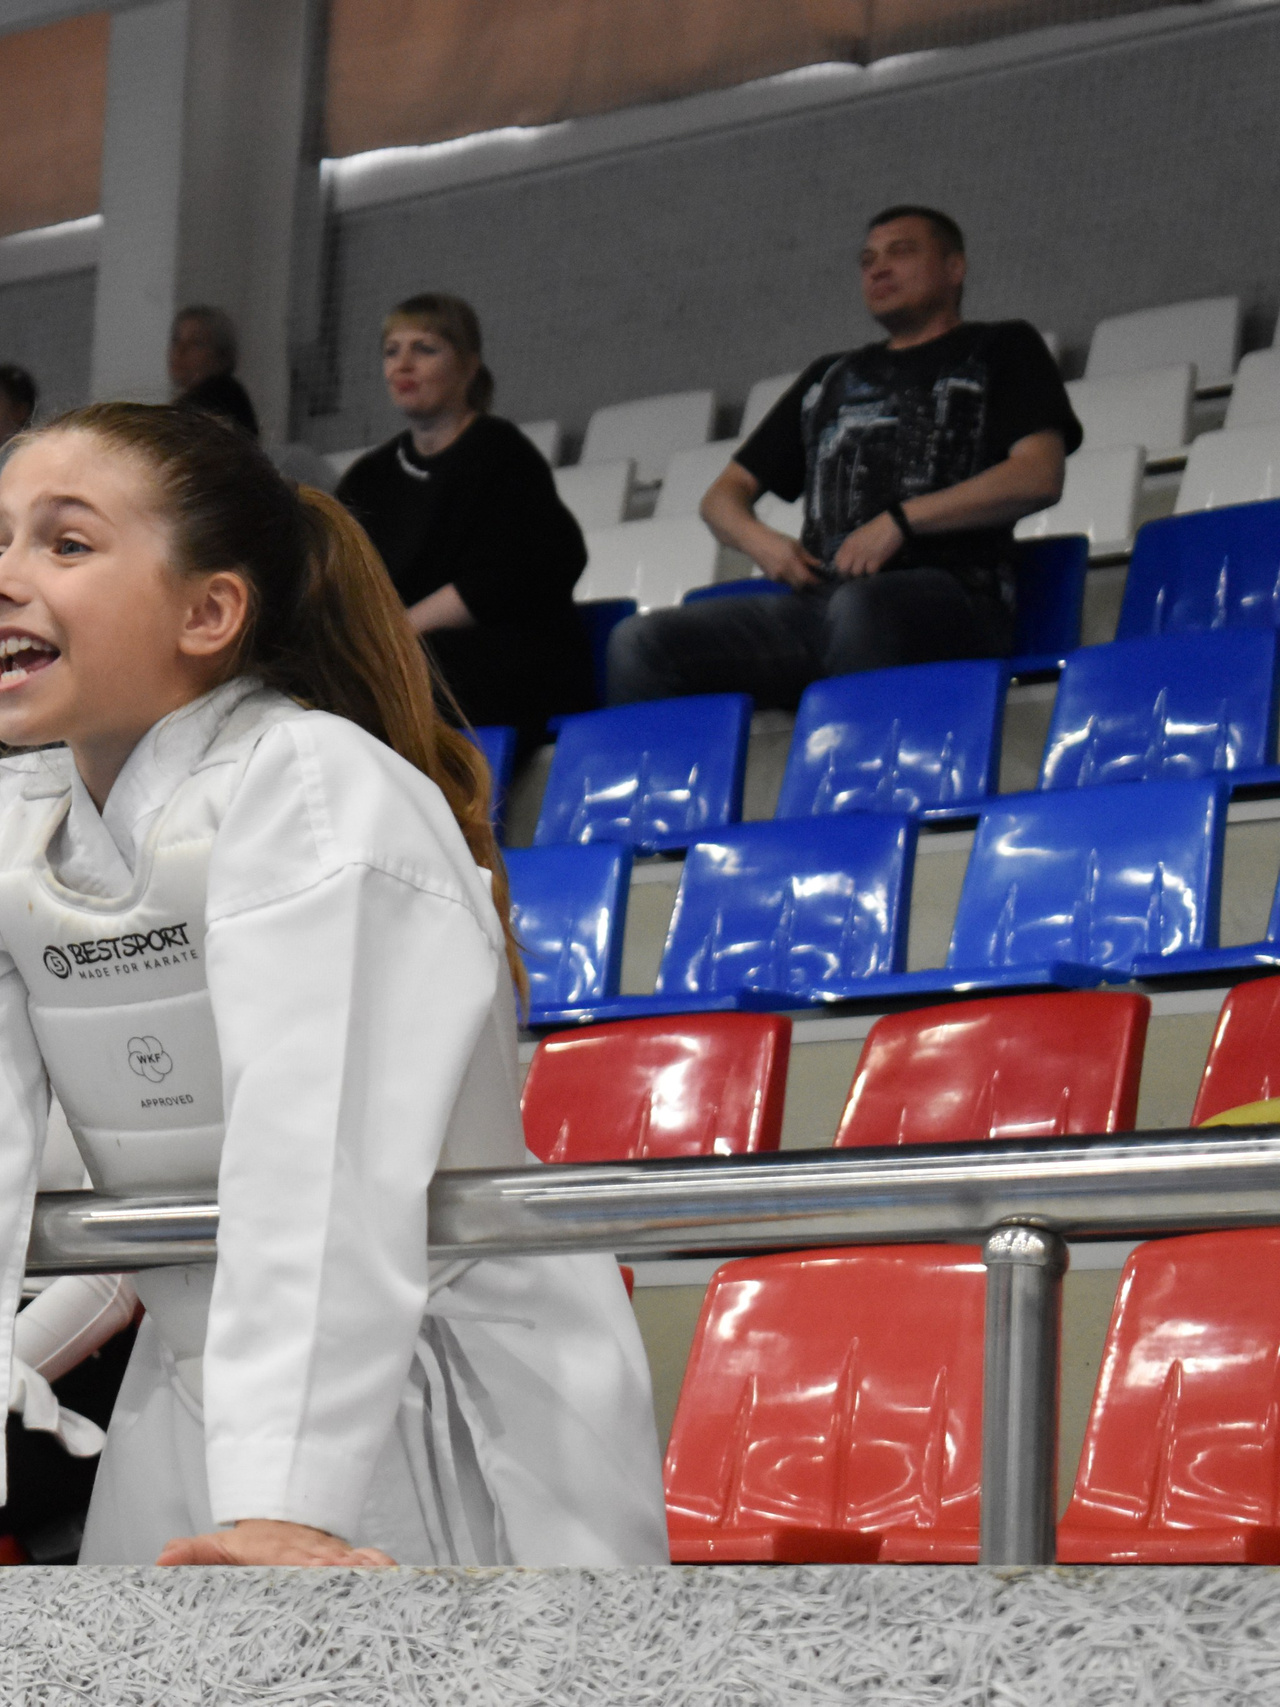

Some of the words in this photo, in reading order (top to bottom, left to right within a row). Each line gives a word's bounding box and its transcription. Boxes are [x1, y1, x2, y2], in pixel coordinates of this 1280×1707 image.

[68, 923, 190, 965] BESTSPORT
[79, 968, 110, 979] MADE
[115, 962, 139, 974] FOR
[144, 949, 199, 970] KARATE
[136, 1053, 162, 1065] WKF
[140, 1094, 194, 1108] APPROVED
